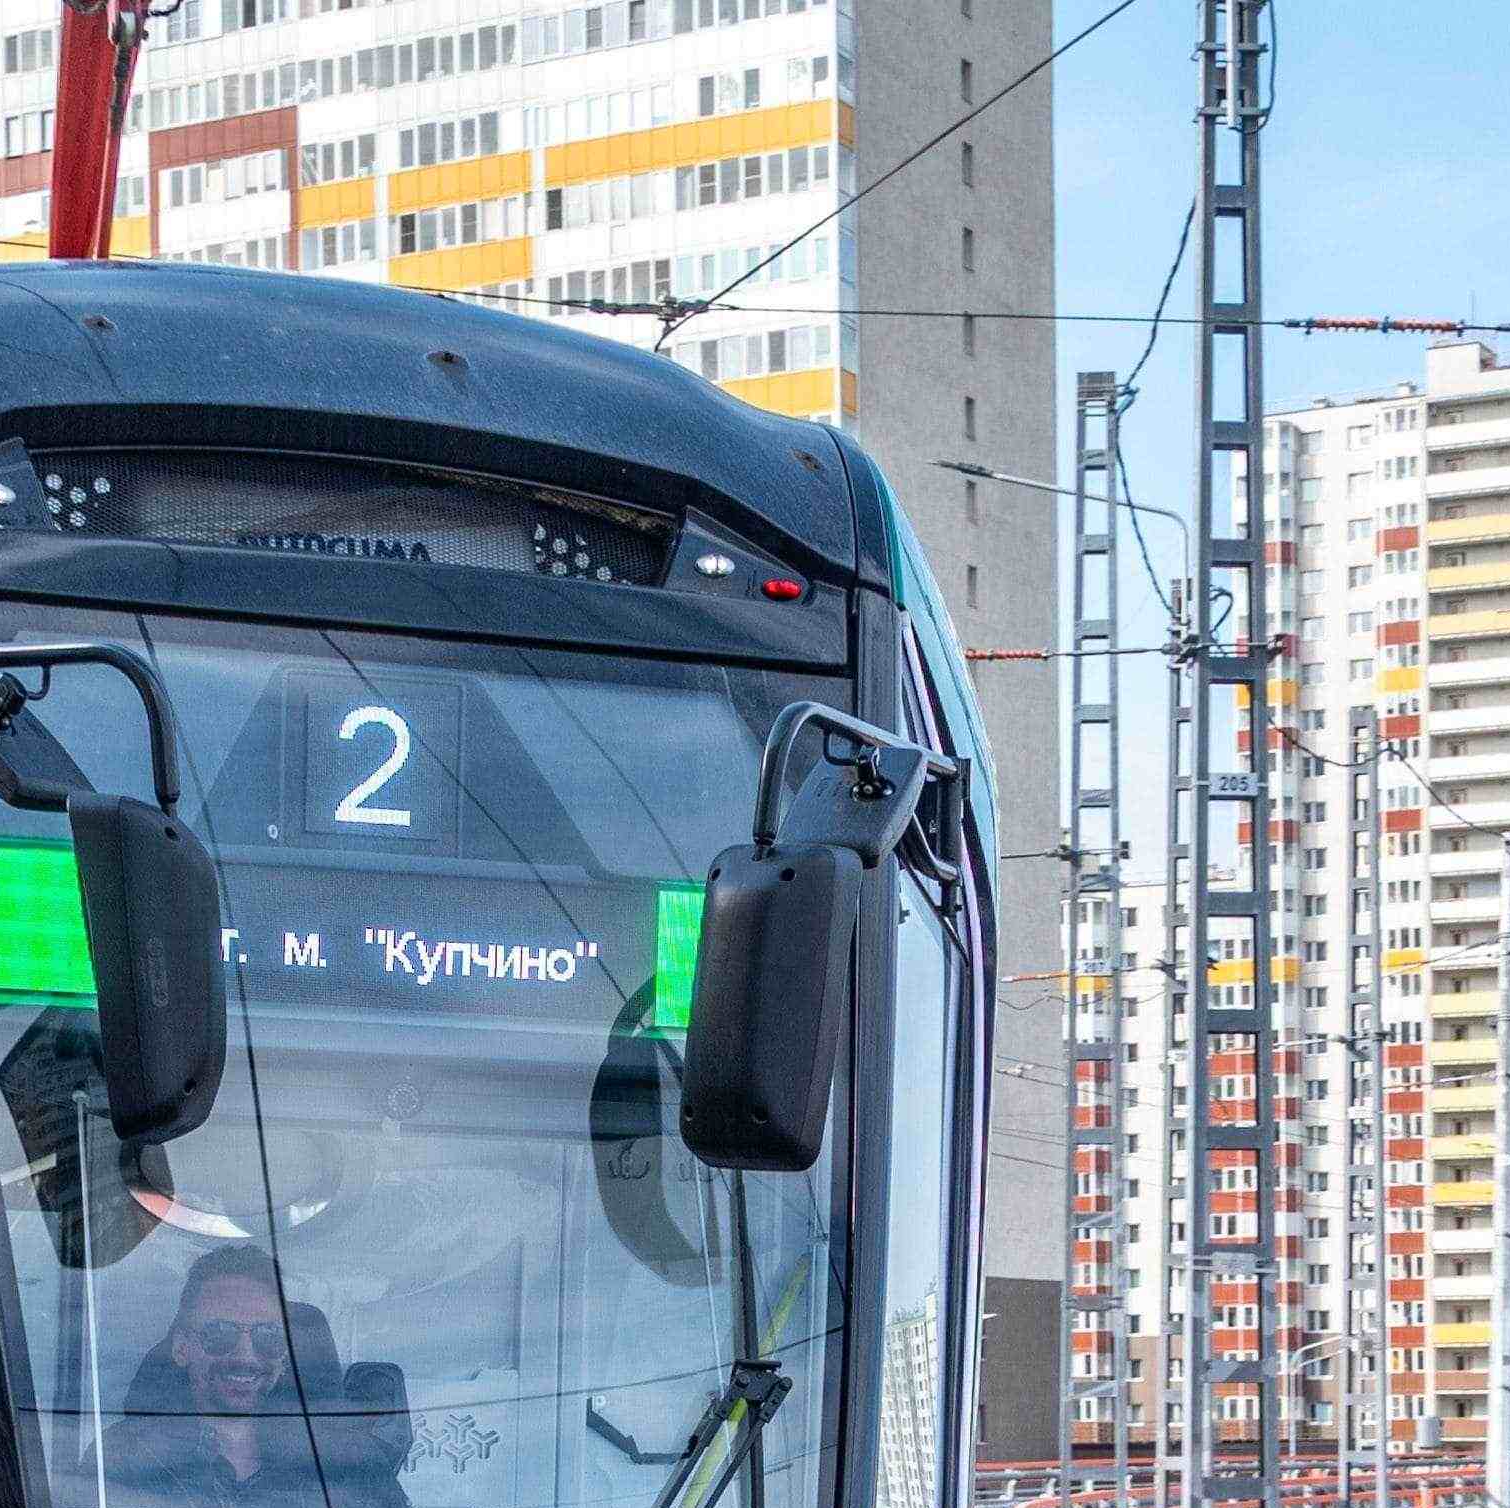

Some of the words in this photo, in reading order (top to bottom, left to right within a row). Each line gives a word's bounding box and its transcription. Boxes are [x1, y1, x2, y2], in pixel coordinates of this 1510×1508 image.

[335, 706, 411, 827] 2
[1219, 776, 1248, 792] 205
[284, 932, 327, 968] м.
[364, 926, 598, 985] "Купчино"
